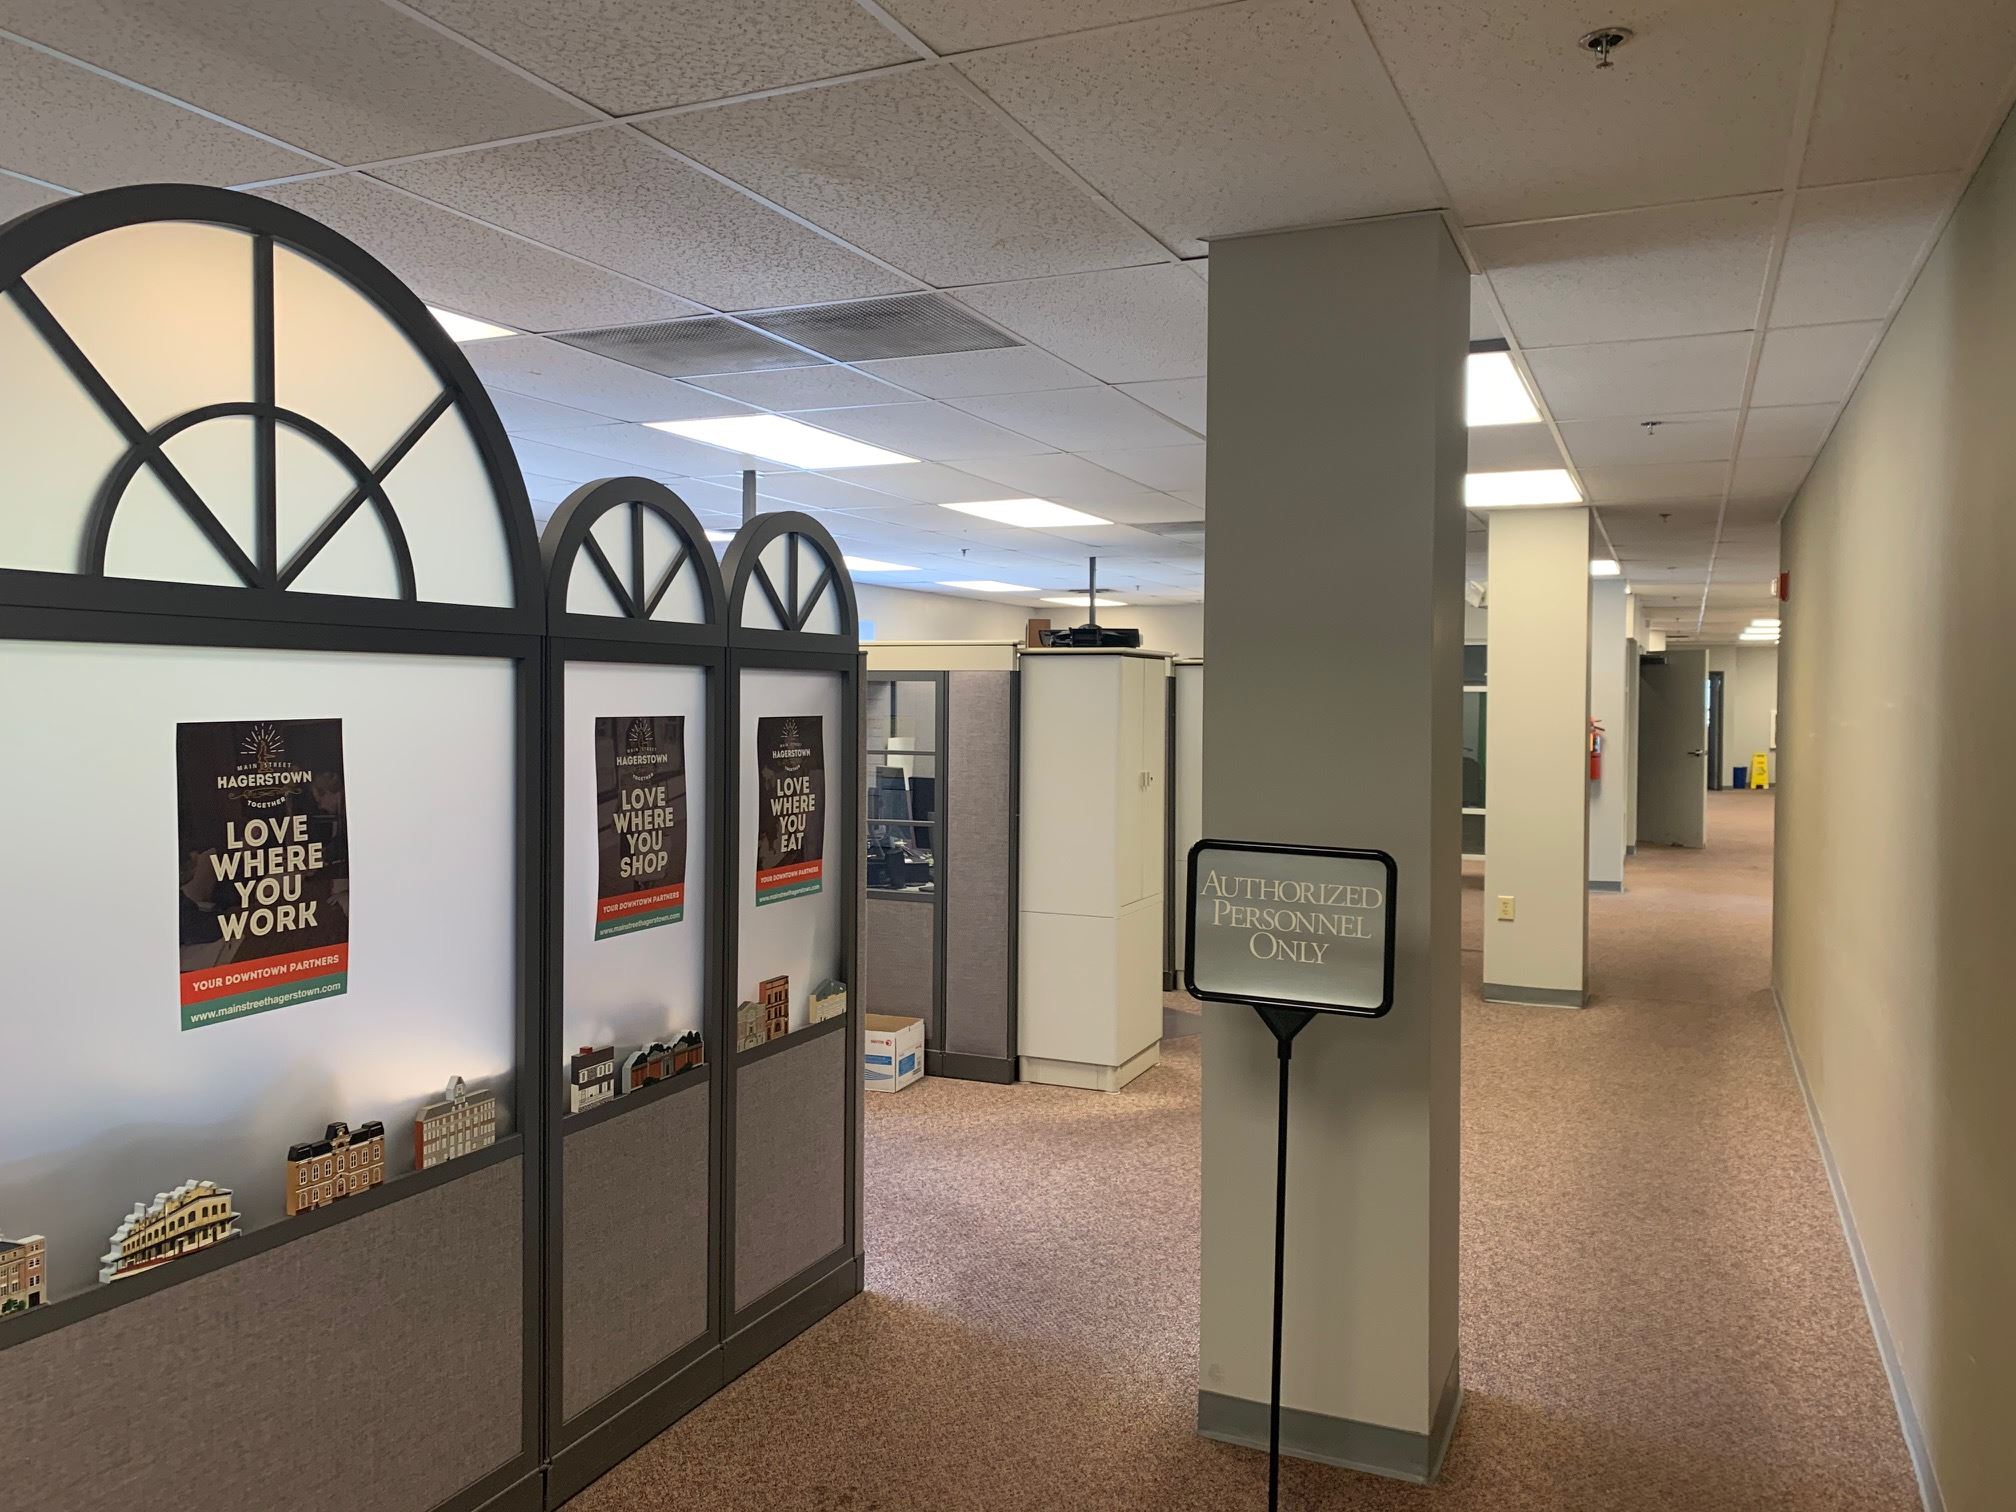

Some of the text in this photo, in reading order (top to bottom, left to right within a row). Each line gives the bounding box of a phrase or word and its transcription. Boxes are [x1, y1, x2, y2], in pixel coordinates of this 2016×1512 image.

[616, 753, 668, 766] HAGERSTOWN
[772, 748, 811, 759] HAGERSTOWN
[217, 770, 312, 789] HAGERSTOWN
[237, 763, 258, 771] MAIN
[621, 786, 666, 811] LOVE
[777, 776, 810, 797] LOVE
[247, 796, 286, 808] TOGETHER
[770, 794, 816, 817] WHERE
[226, 814, 309, 850] LOVE
[613, 807, 674, 834] WHERE
[779, 813, 806, 834] YOU
[627, 830, 663, 854] YOU
[781, 832, 805, 853] EAT
[210, 842, 324, 882] WHERE
[620, 851, 668, 878] SHOP
[234, 874, 302, 909] YOU
[1200, 869, 1383, 909] AUTHORIZED
[603, 891, 680, 914] YOUR DOWNTOWN PARTNERS
[217, 900, 319, 942] WORK
[1212, 898, 1372, 939] PERSONNEL
[1249, 931, 1330, 965] ONLY
[192, 954, 340, 992] YOUR DOWNTOWN PARTNERS
[190, 981, 341, 1024] www.mainstreethagerstown.com
